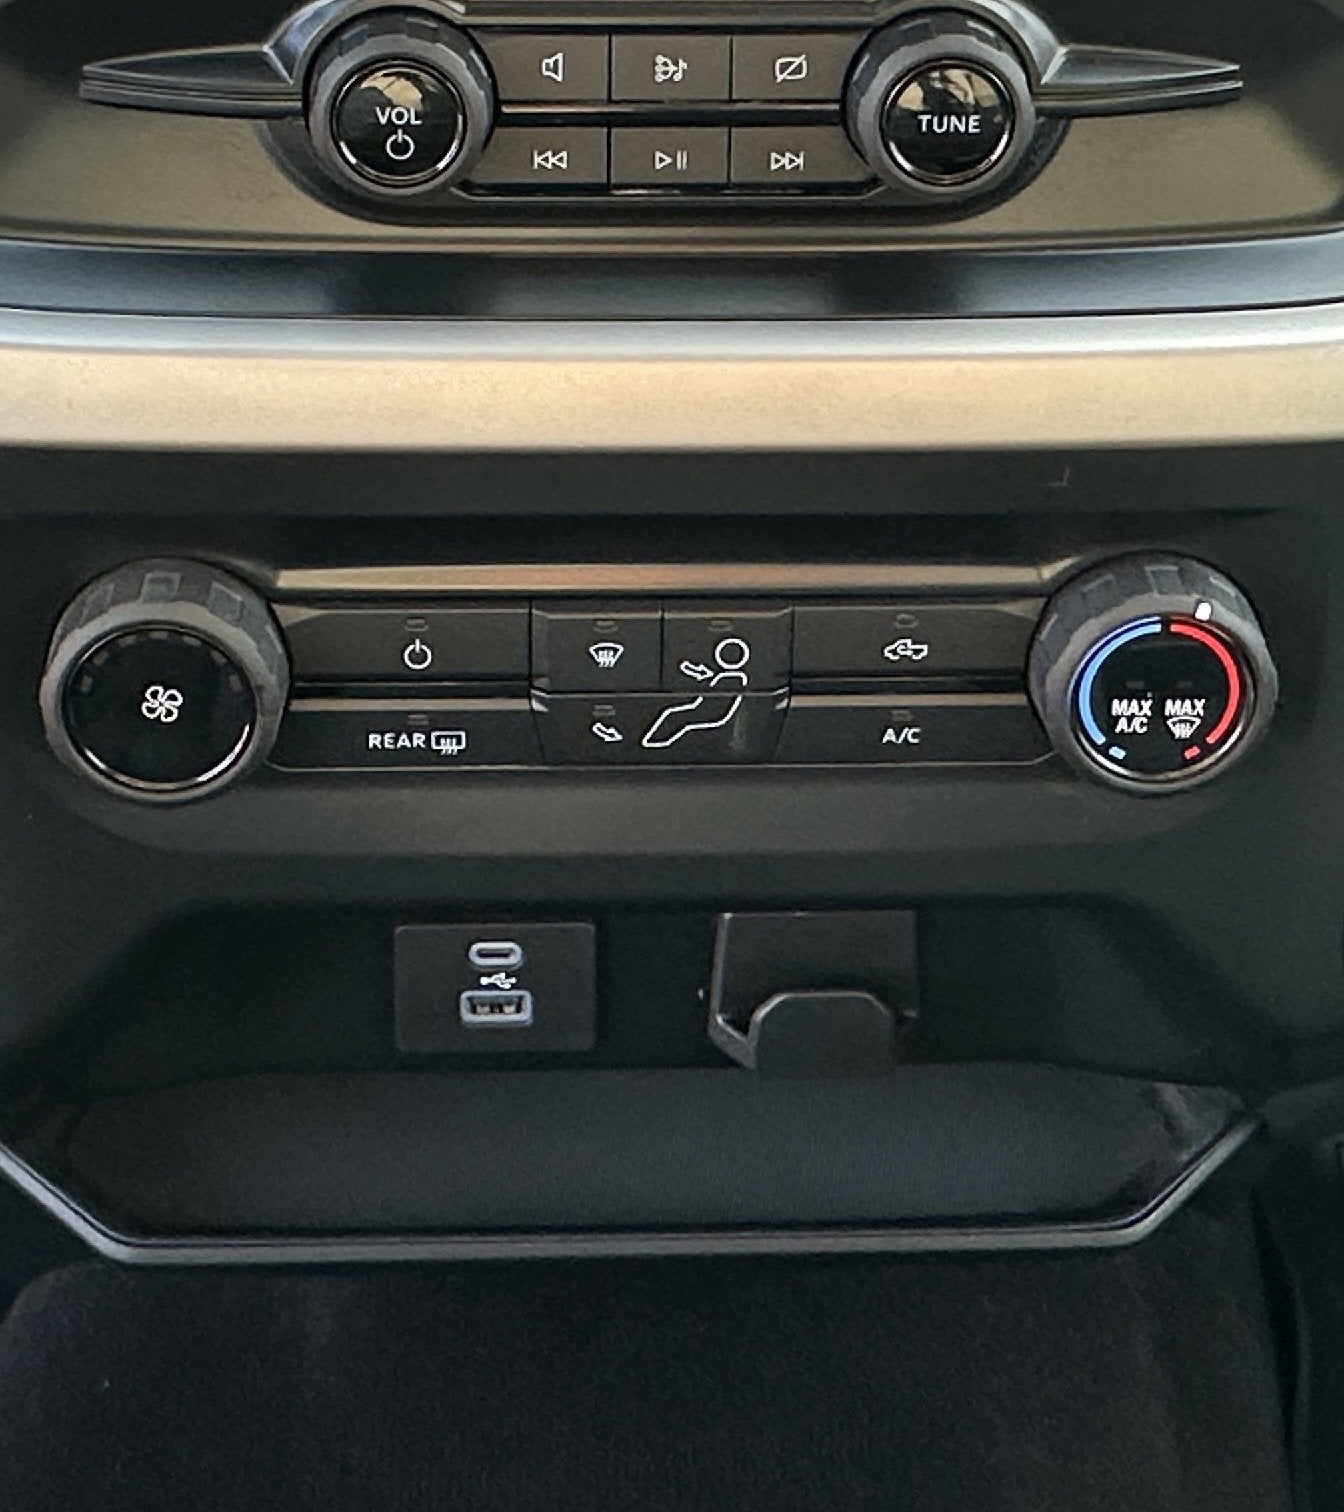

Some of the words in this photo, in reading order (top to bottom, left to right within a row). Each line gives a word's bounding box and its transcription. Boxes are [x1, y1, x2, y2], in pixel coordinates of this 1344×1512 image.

[375, 106, 422, 126] VOL
[918, 115, 981, 135] TUNE
[1111, 698, 1154, 716] MAX
[1164, 698, 1206, 716] MAX
[1114, 716, 1149, 734] A/C
[368, 732, 427, 749] REAR
[882, 727, 922, 745] A/C
